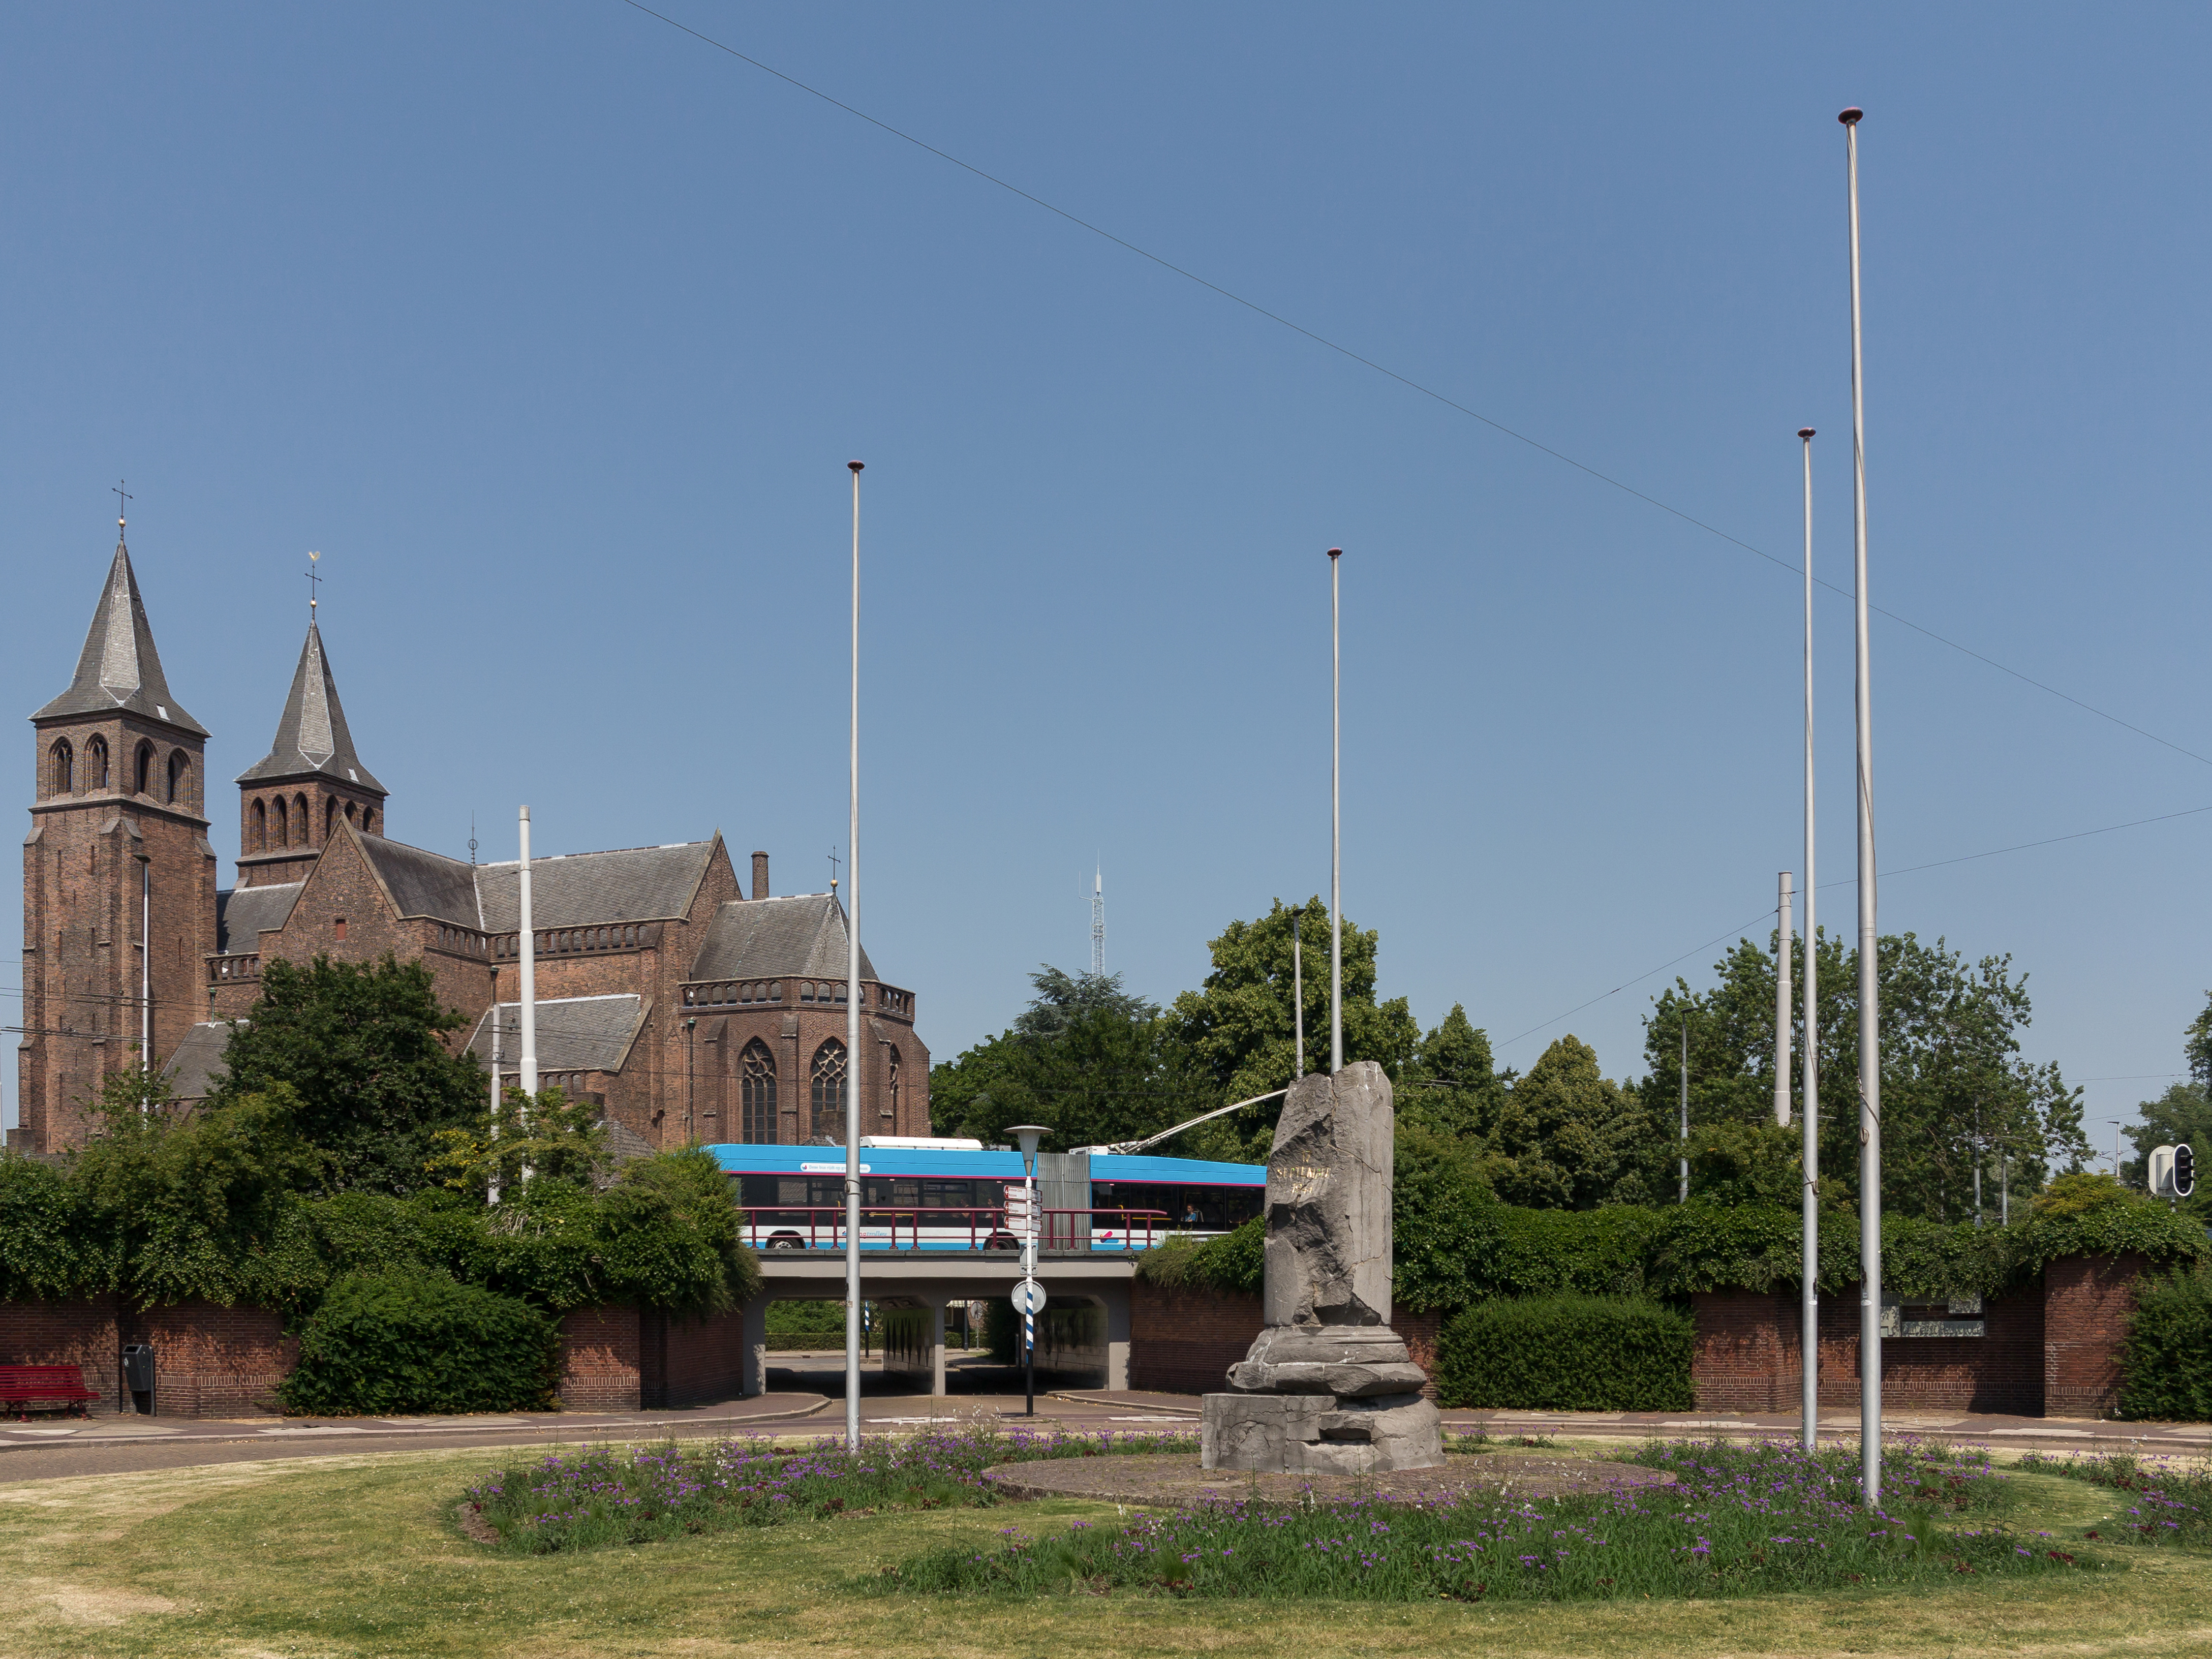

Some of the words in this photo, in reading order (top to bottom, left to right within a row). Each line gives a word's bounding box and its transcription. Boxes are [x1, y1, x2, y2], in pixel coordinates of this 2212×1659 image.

[1302, 1150, 1311, 1162] 17
[1277, 1166, 1331, 1179] SEPTEMBER
[1292, 1183, 1312, 1194] 1944
